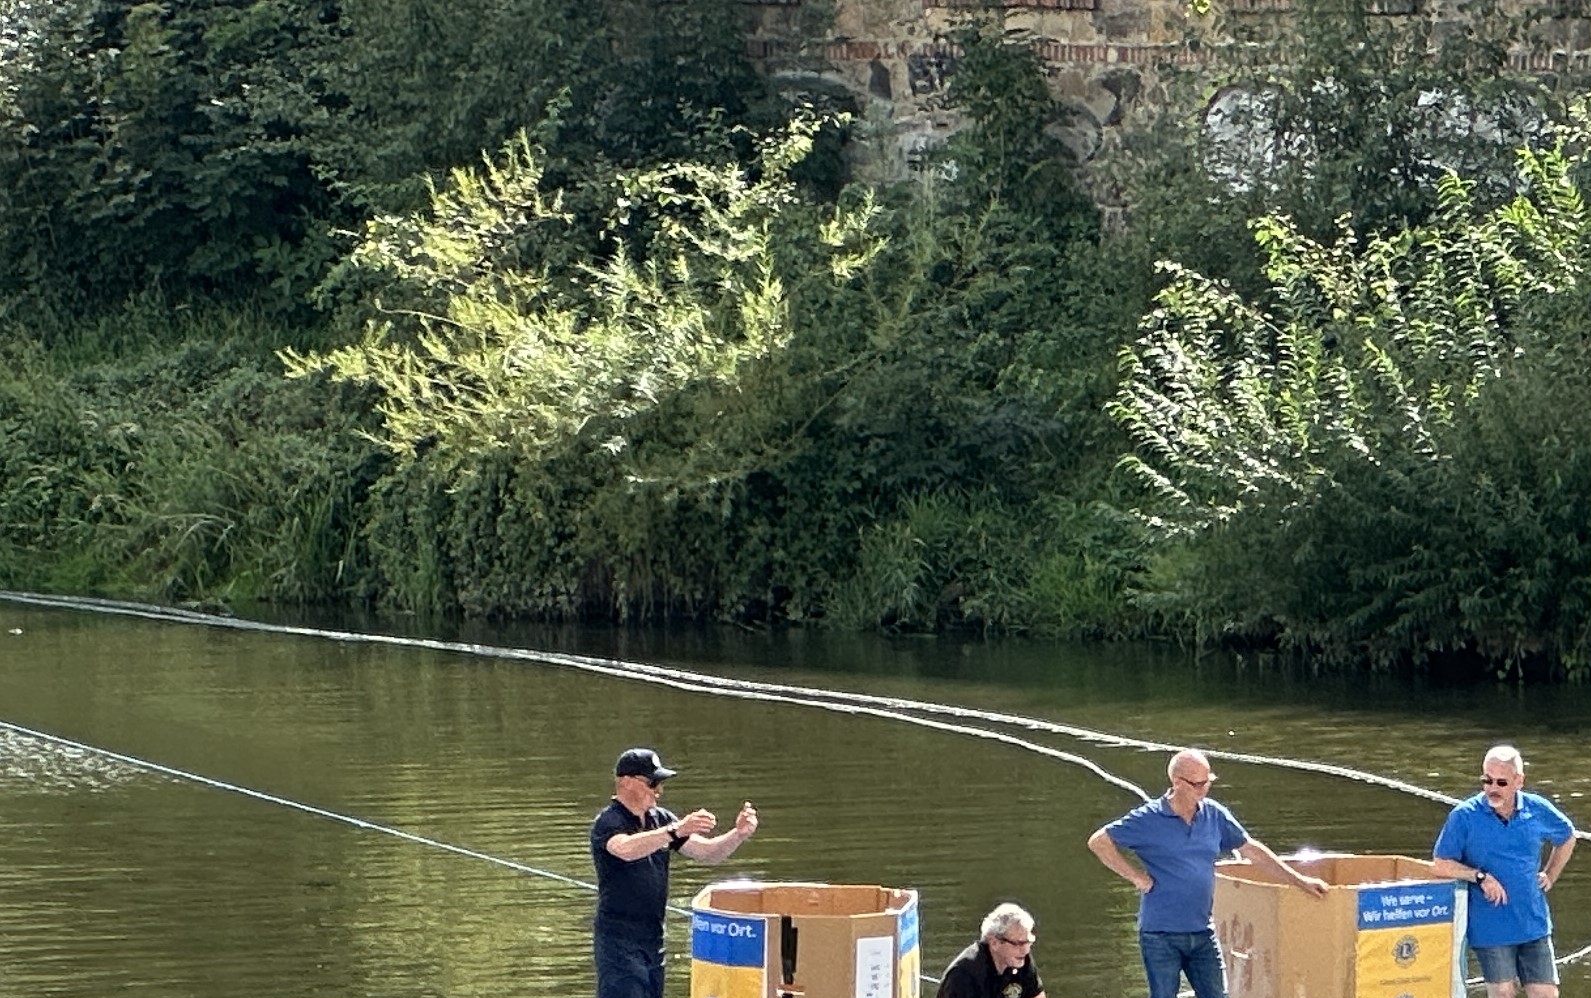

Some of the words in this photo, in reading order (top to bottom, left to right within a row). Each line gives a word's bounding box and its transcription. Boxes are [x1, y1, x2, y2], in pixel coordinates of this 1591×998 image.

[1381, 895, 1398, 907] We
[1399, 894, 1425, 905] serve
[1383, 907, 1413, 921] helfen
[1414, 909, 1431, 919] vor
[727, 922, 757, 938] Ort.
